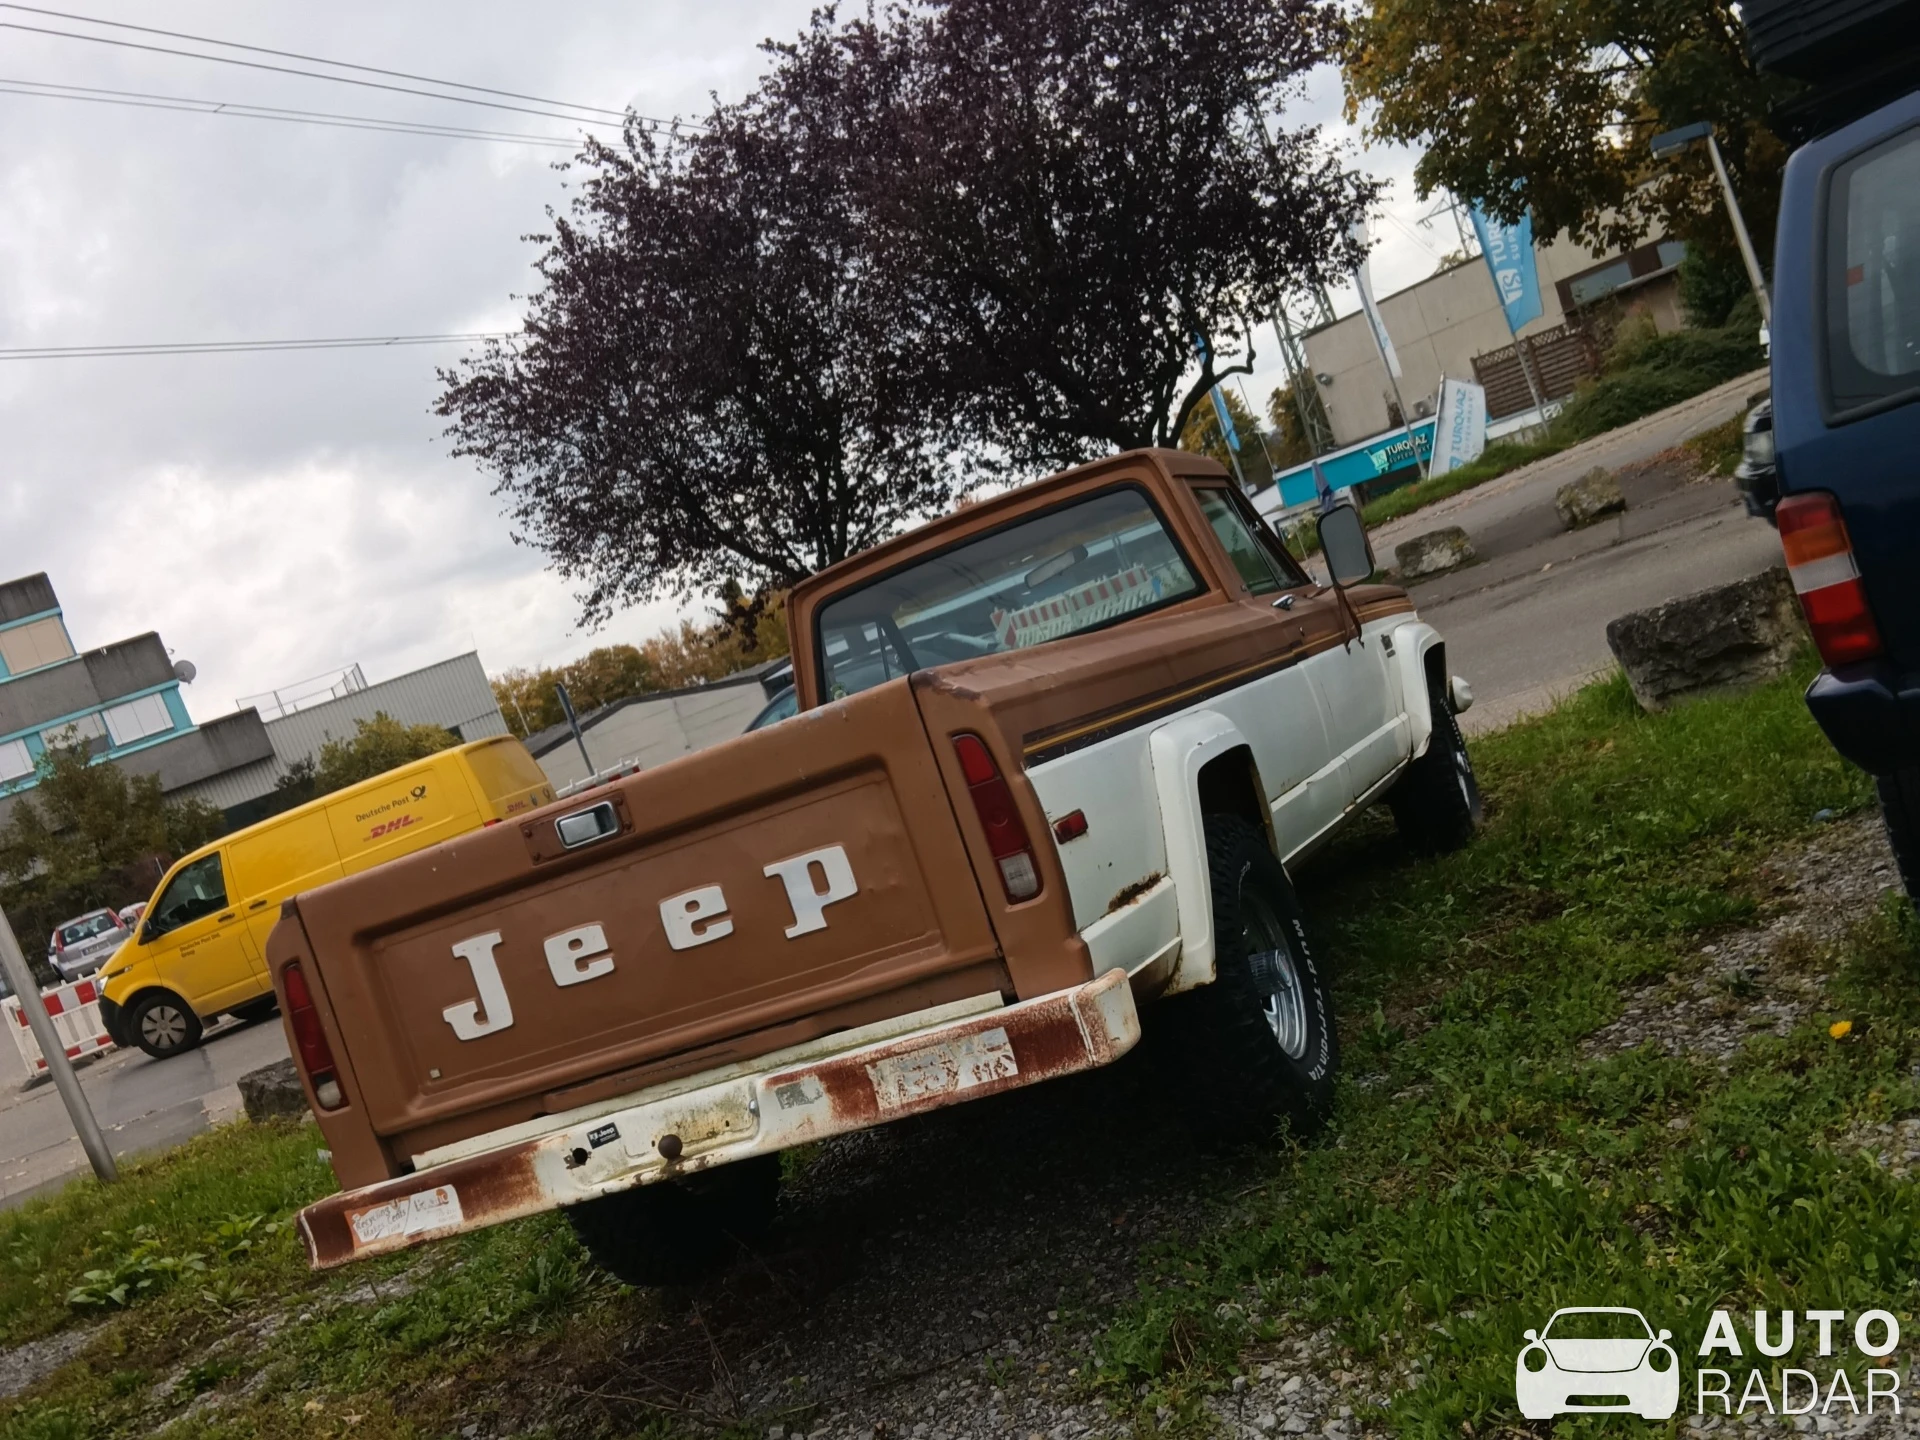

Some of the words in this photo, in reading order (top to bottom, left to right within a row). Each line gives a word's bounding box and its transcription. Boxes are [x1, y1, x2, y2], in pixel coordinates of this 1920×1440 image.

[1452, 388, 1467, 452] TURQUAZ
[355, 803, 391, 822] Deutsche
[392, 796, 410, 808] Post
[371, 814, 414, 839] DHL
[442, 845, 858, 1041] Jeep
[1292, 919, 1330, 1066] Mud-Terrain
[599, 1127, 615, 1138] Jeep
[356, 1206, 391, 1230] Recycling
